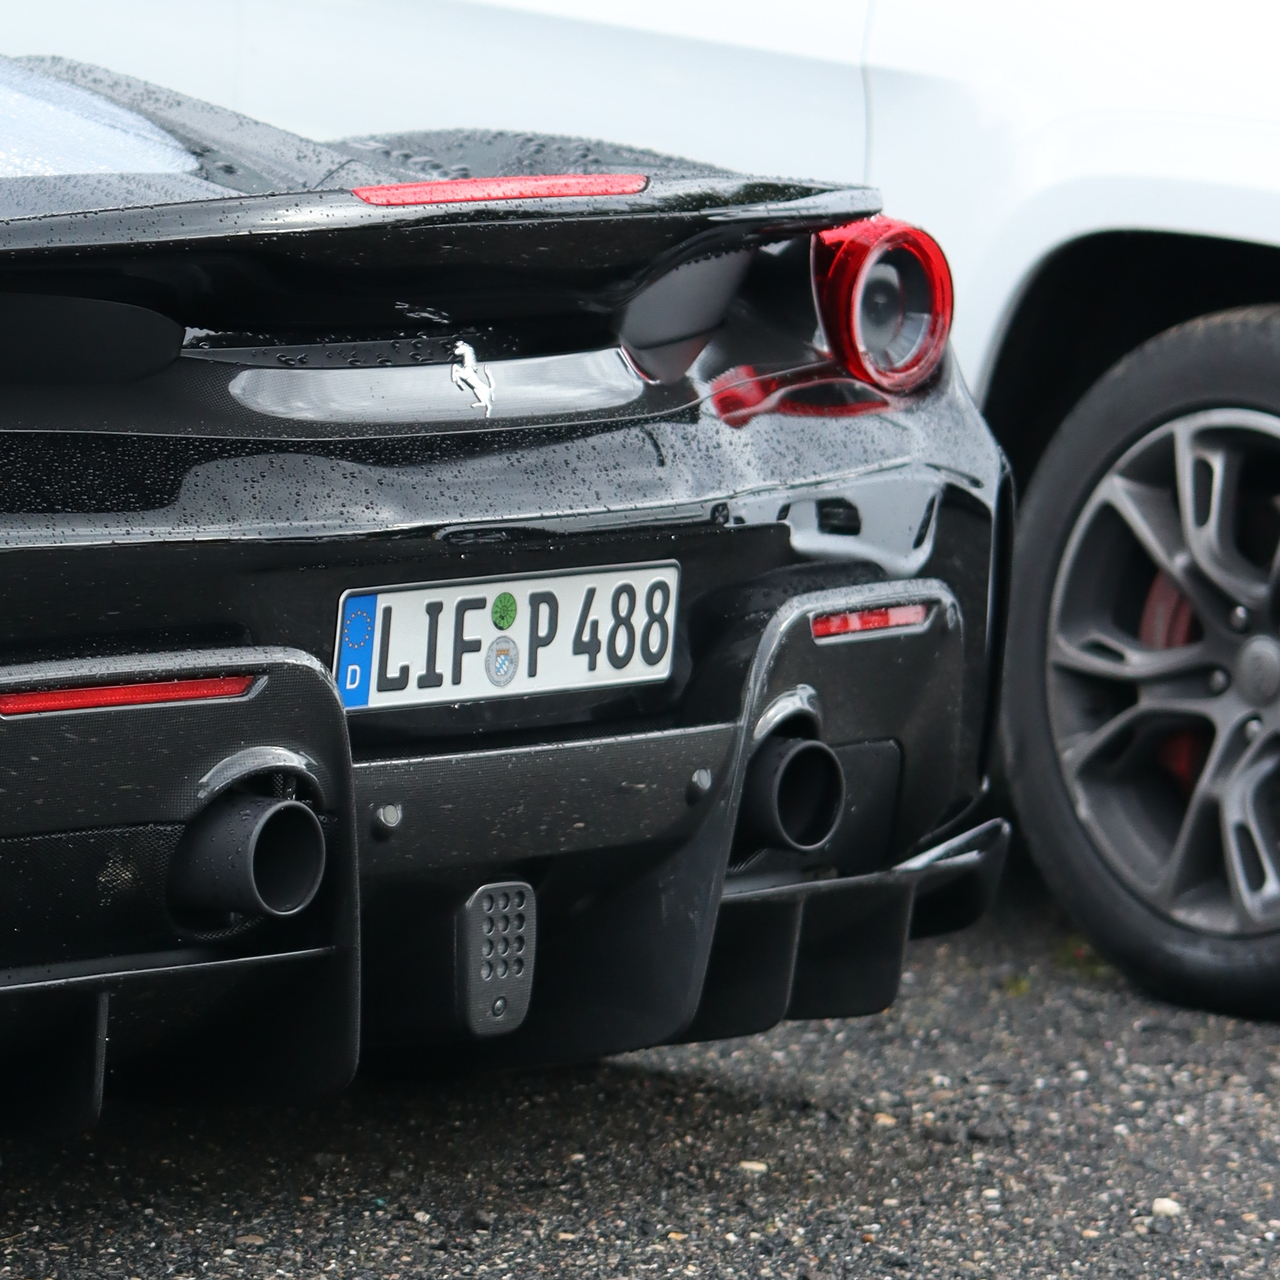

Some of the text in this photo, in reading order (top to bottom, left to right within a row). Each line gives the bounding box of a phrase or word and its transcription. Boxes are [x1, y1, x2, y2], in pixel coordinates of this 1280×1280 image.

[376, 597, 488, 693] LIF
[527, 590, 559, 678] P
[572, 580, 671, 672] 488
[346, 664, 361, 690] D
